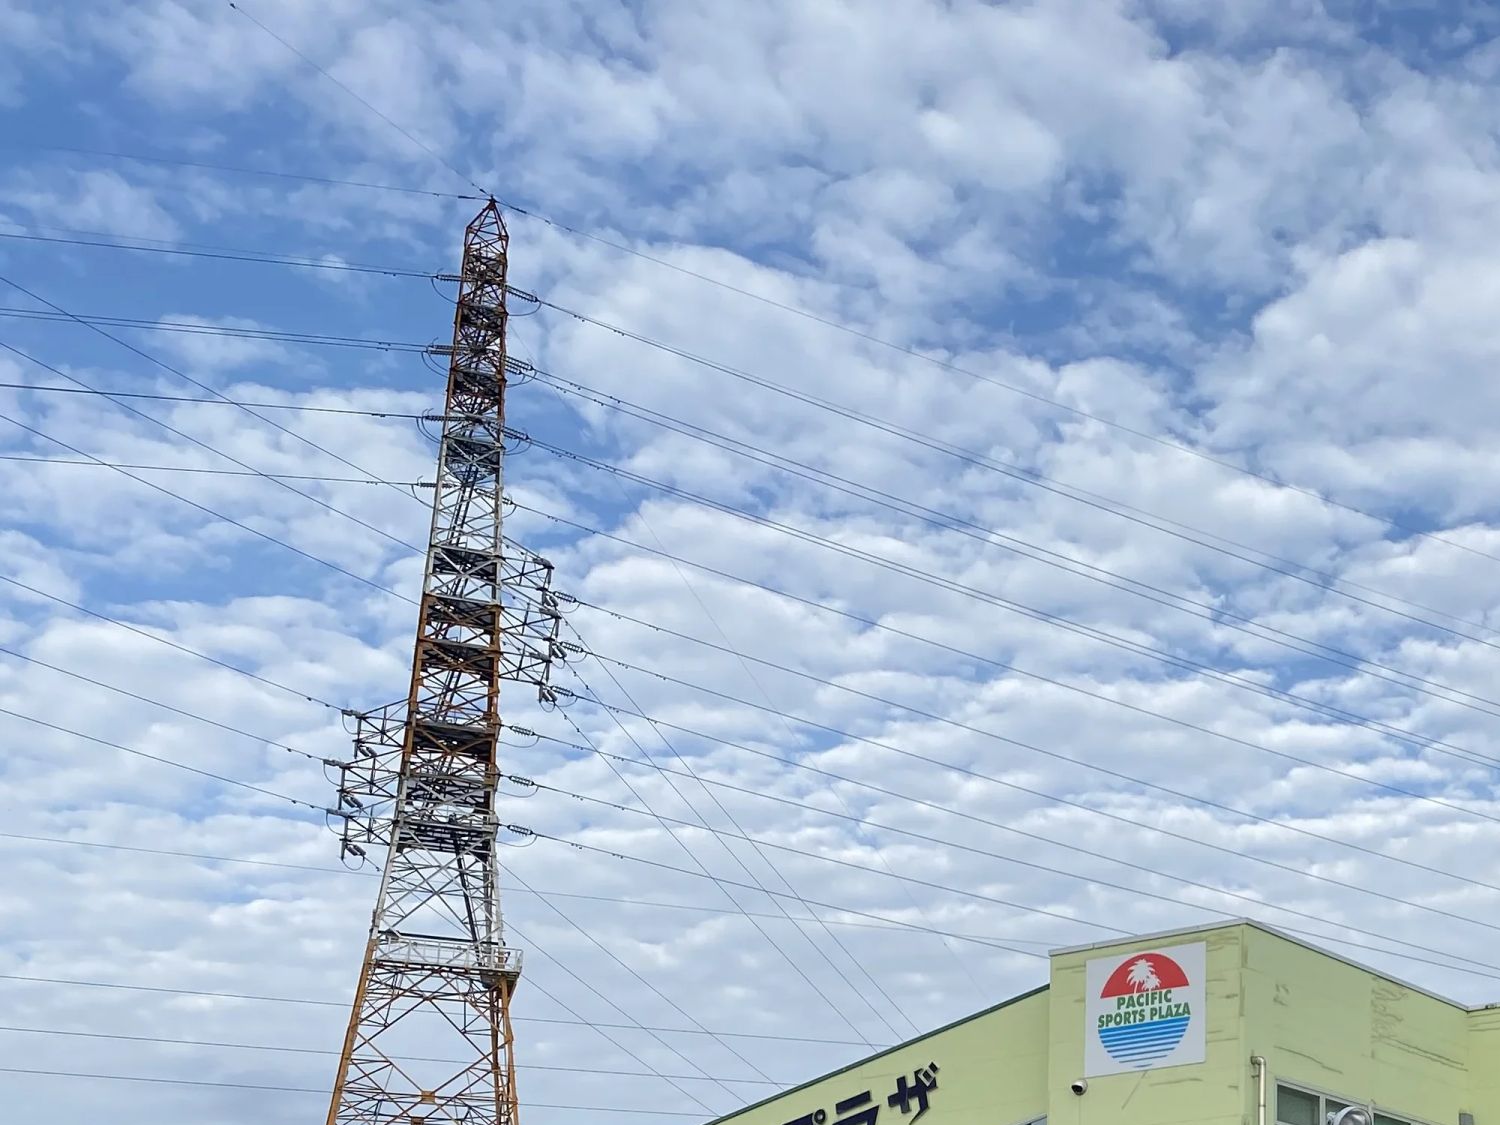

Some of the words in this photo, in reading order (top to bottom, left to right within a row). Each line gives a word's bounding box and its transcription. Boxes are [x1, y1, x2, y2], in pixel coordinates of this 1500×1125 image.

[1117, 989, 1172, 1010] PACIFIC
[1098, 1009, 1145, 1028] SPORTS
[1150, 1002, 1191, 1020] PLAZA
